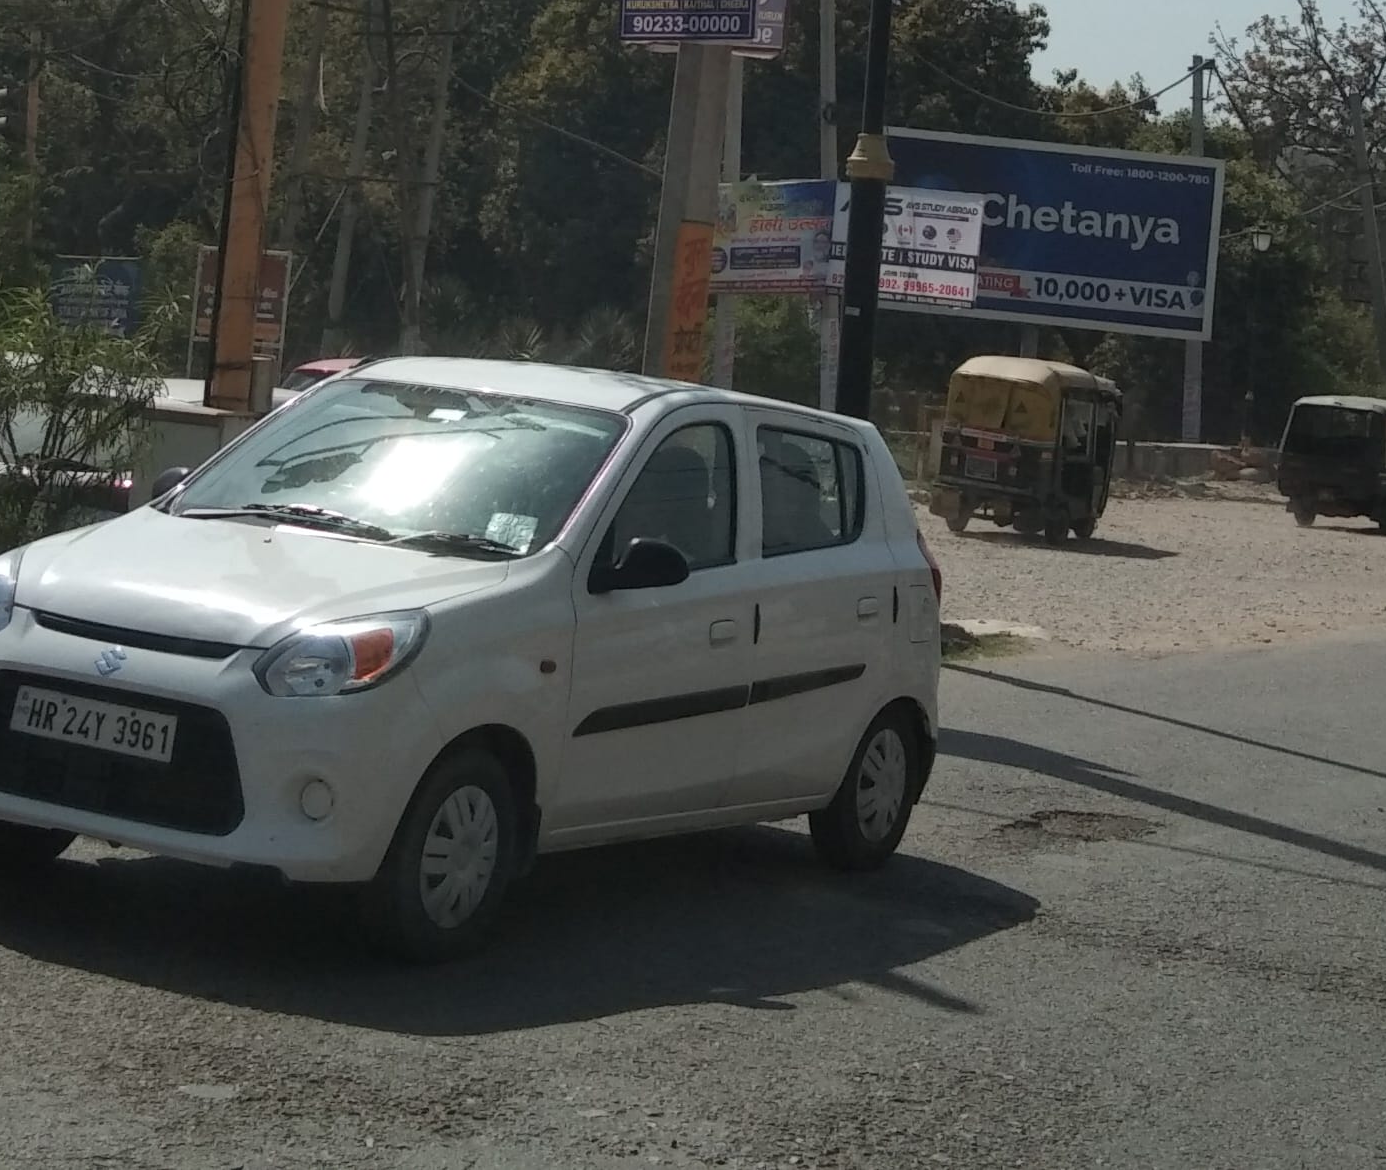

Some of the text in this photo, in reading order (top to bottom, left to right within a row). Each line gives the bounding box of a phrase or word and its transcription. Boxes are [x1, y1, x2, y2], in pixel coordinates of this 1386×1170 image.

[633, 15, 741, 33] 90233-00000
[1071, 162, 1093, 175] Toll
[1095, 165, 1124, 177] Free:
[982, 192, 1180, 251] Chetanya
[907, 253, 946, 267] STUDY
[947, 255, 976, 271] VISA
[1130, 286, 1186, 311] VISA
[27, 698, 169, 754] HR 24Y 3961
